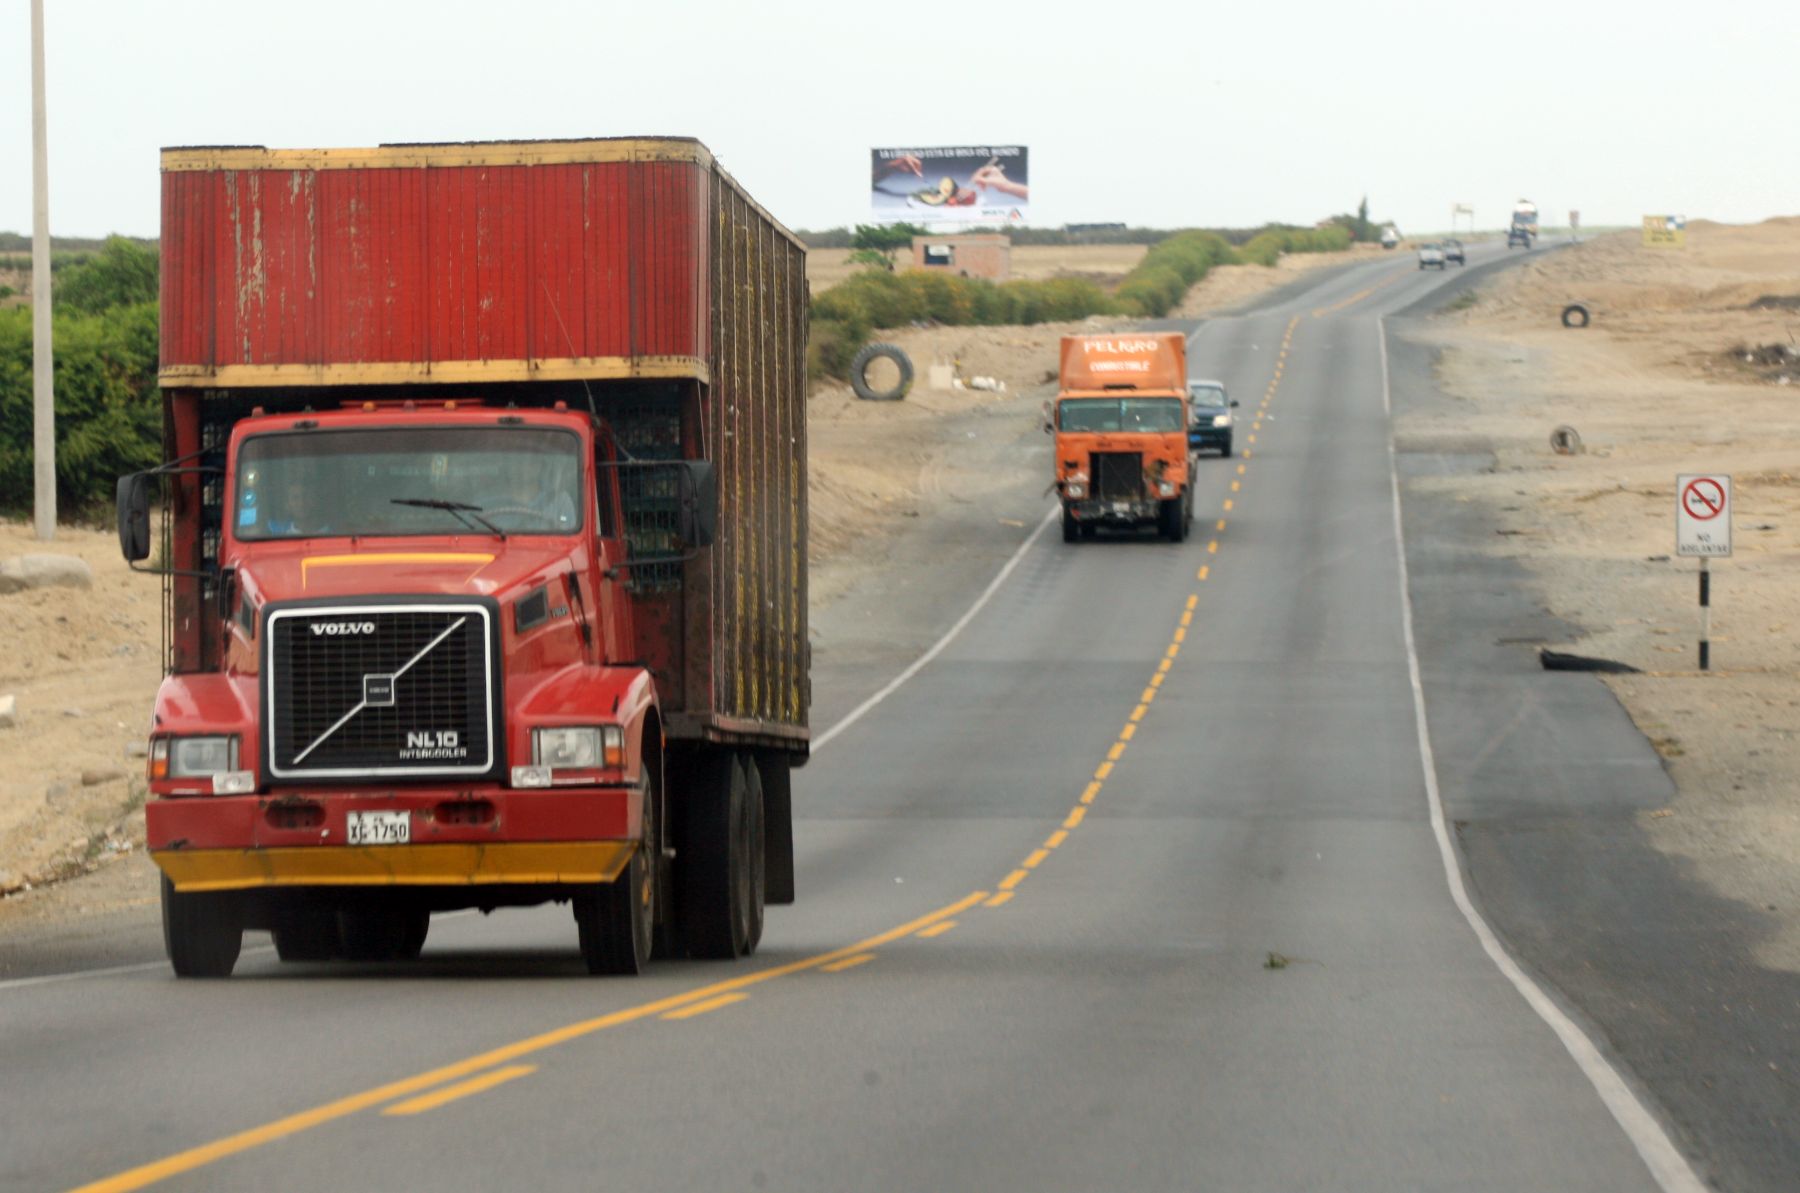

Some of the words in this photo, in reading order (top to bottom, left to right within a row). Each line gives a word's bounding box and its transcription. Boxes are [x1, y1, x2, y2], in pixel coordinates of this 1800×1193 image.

[1083, 339, 1158, 355] PELIGRO
[1696, 532, 1711, 542] NO
[310, 621, 375, 636] VOLVO
[407, 730, 458, 748] NL10
[399, 747, 467, 760] INTERCOOLER
